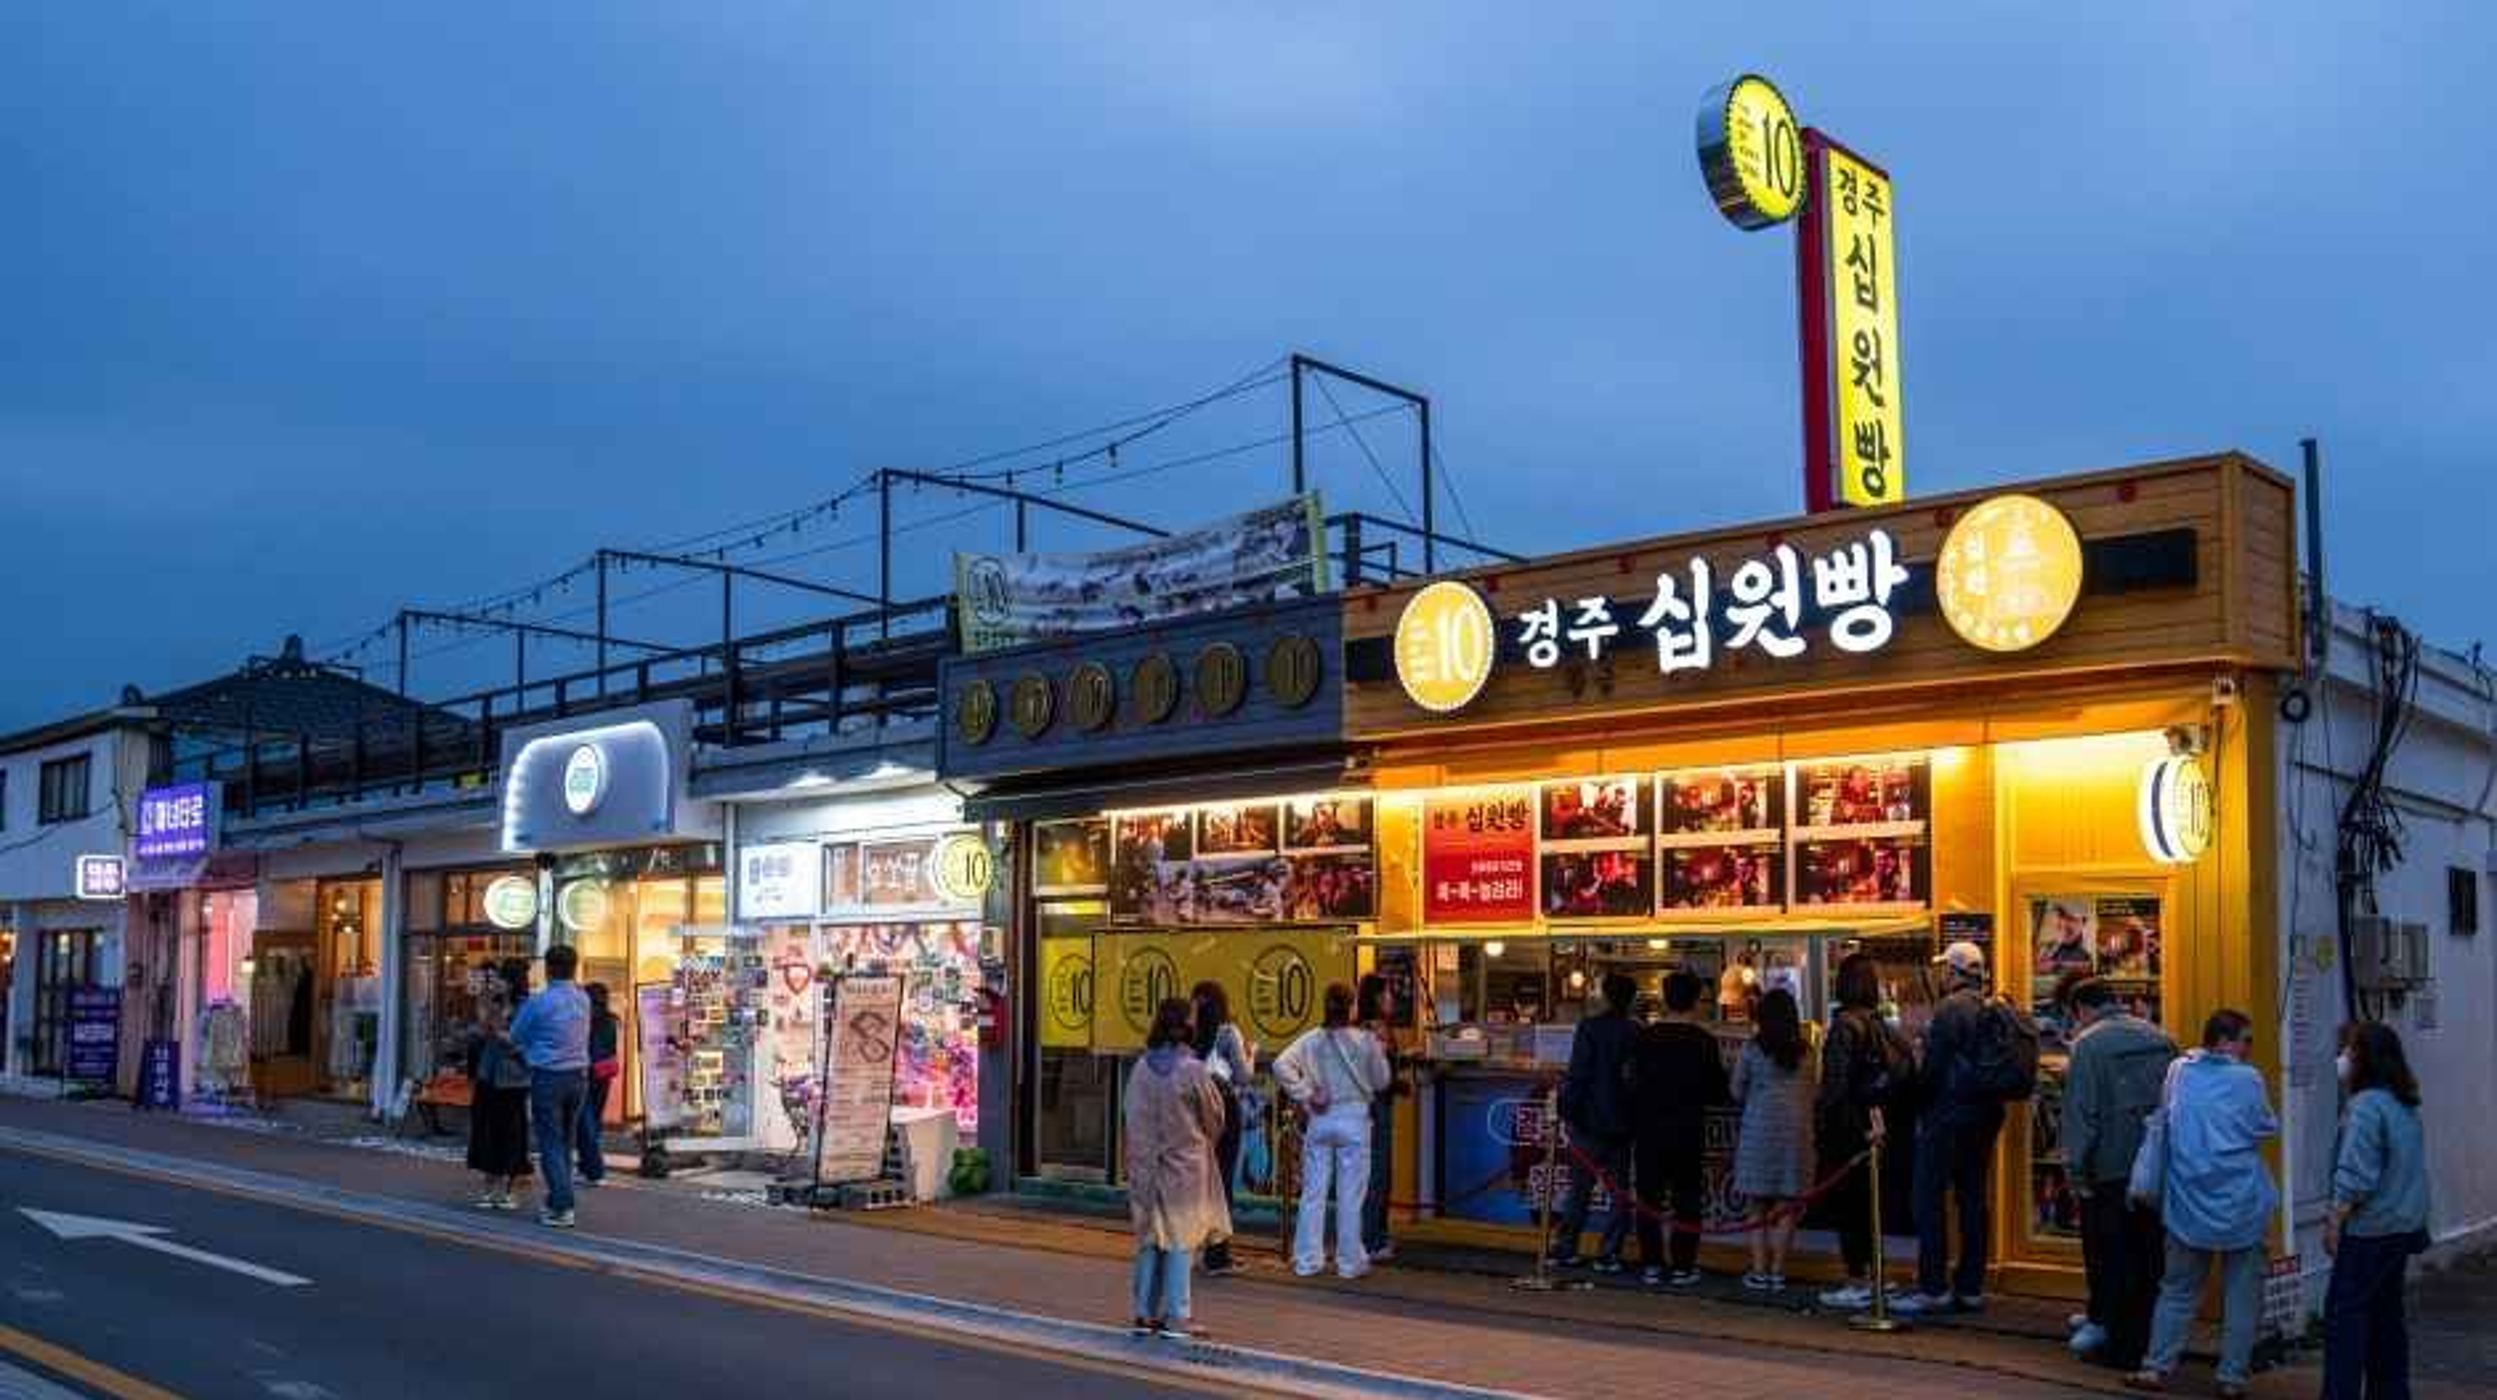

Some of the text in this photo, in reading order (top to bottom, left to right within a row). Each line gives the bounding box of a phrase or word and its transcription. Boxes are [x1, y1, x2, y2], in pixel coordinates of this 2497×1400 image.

[1764, 111, 1796, 198] 10
[1837, 168, 1886, 229] 경주
[1846, 233, 1890, 498] 십원빵
[1518, 595, 1620, 668] 경주
[1638, 529, 1909, 675] 십원빵
[1436, 606, 1484, 683] 10
[965, 851, 987, 886] 10
[1072, 970, 1092, 1015] 10
[1146, 963, 1174, 1015] 10
[1278, 963, 1307, 1018] 10
